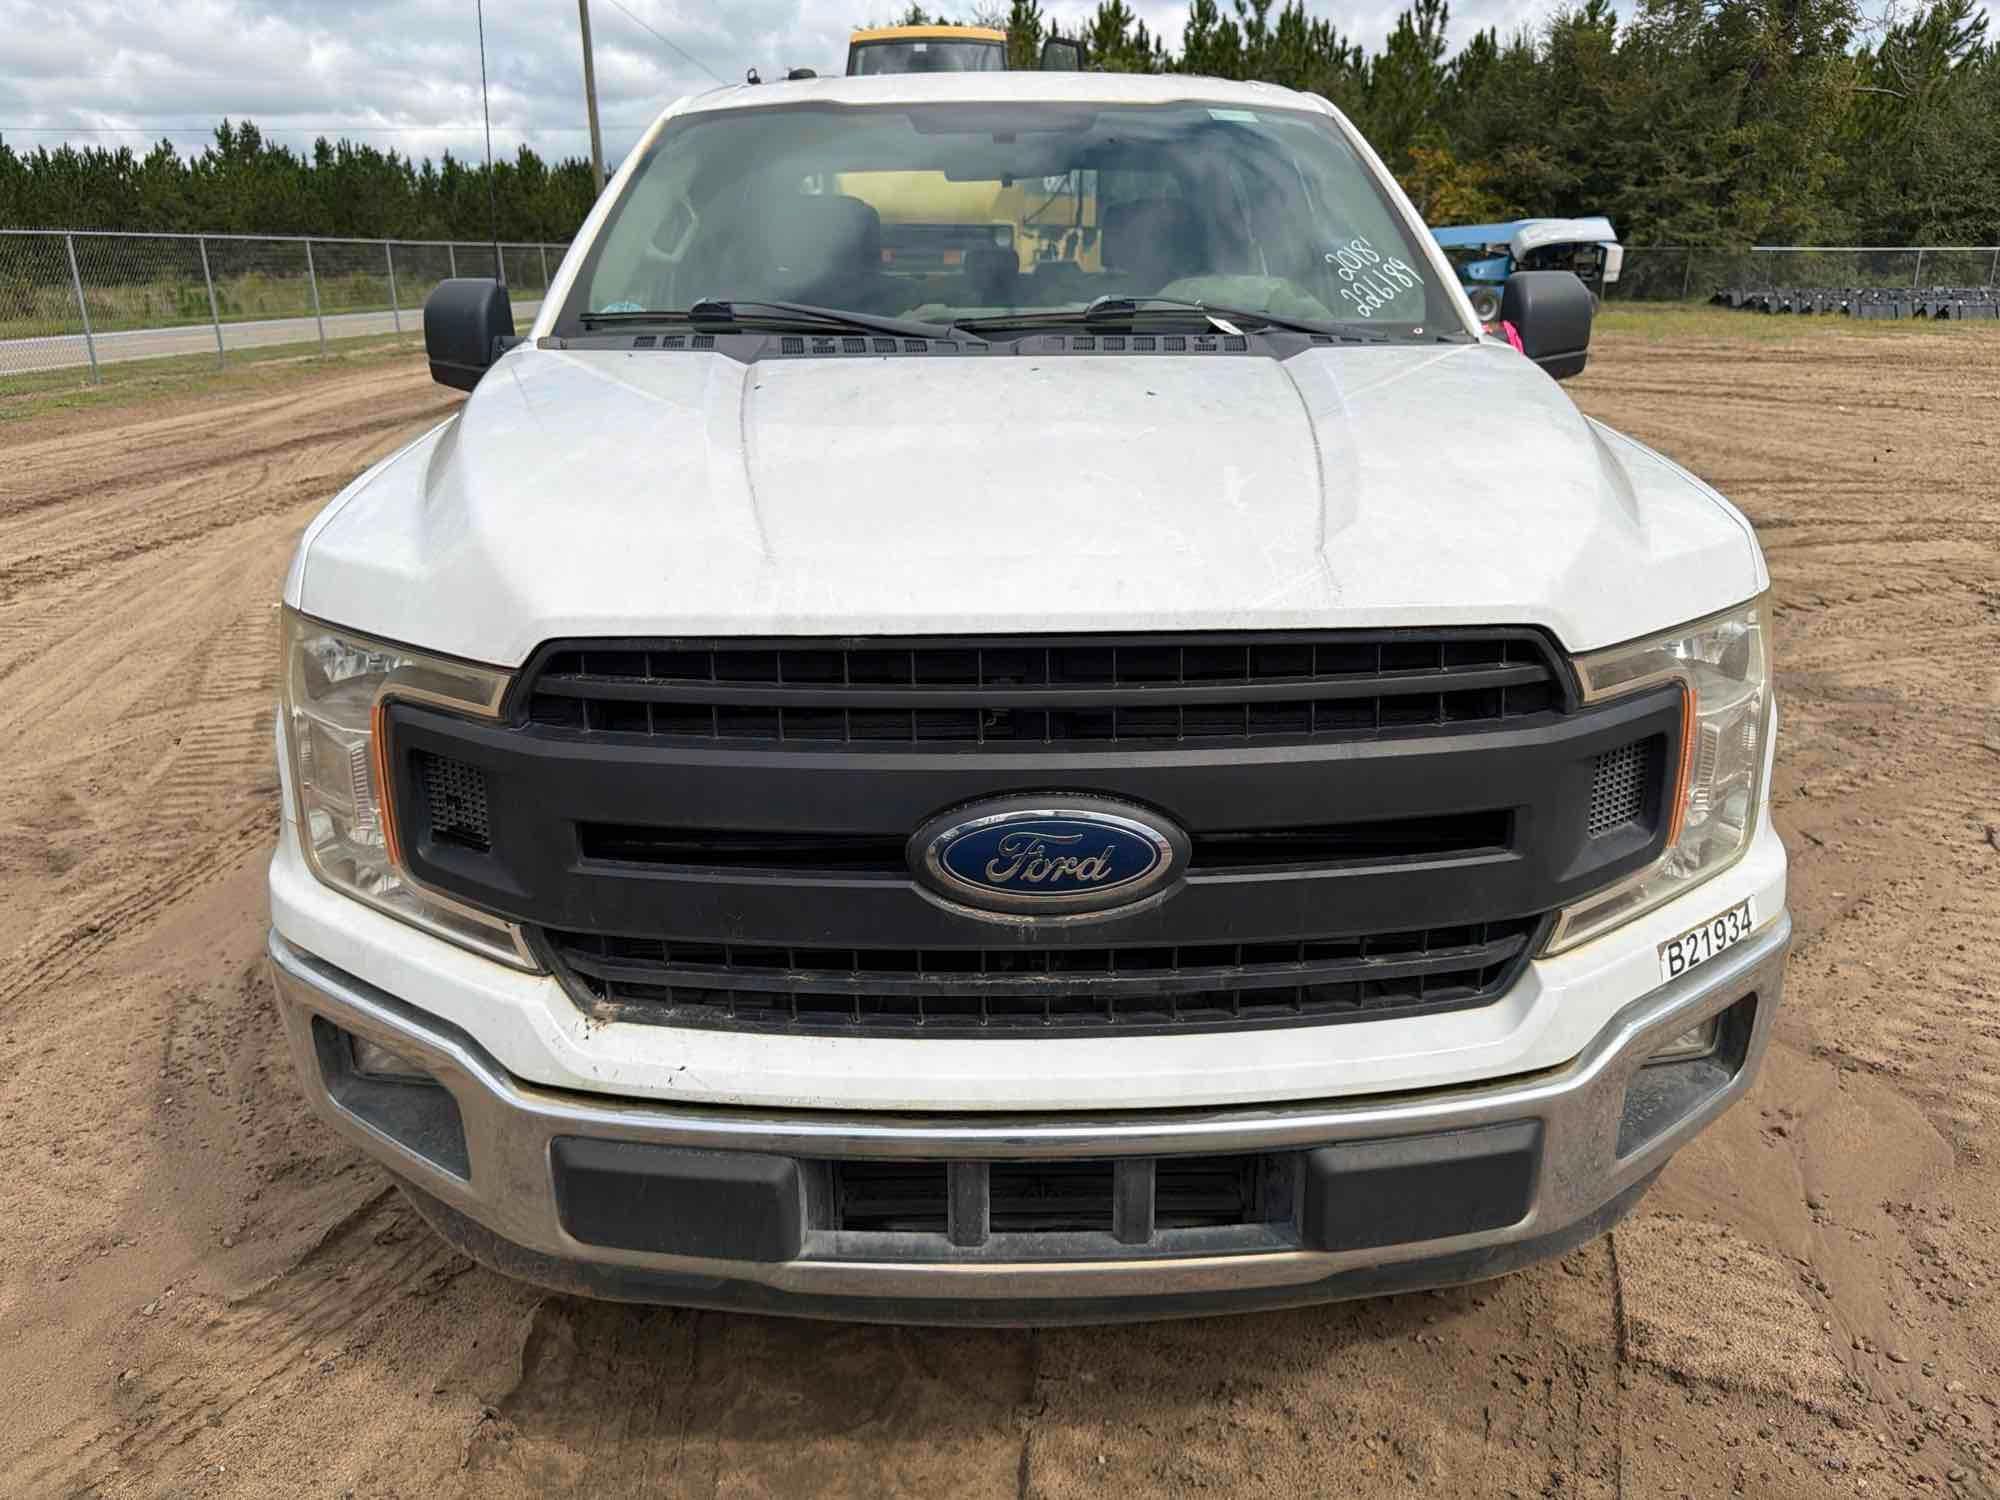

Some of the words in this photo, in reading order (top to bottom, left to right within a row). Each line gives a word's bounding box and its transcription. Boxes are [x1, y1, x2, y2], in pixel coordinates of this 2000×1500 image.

[1340, 257, 1425, 317] 226189
[985, 831, 1115, 881] Ford
[1668, 897, 1752, 977] B21934
